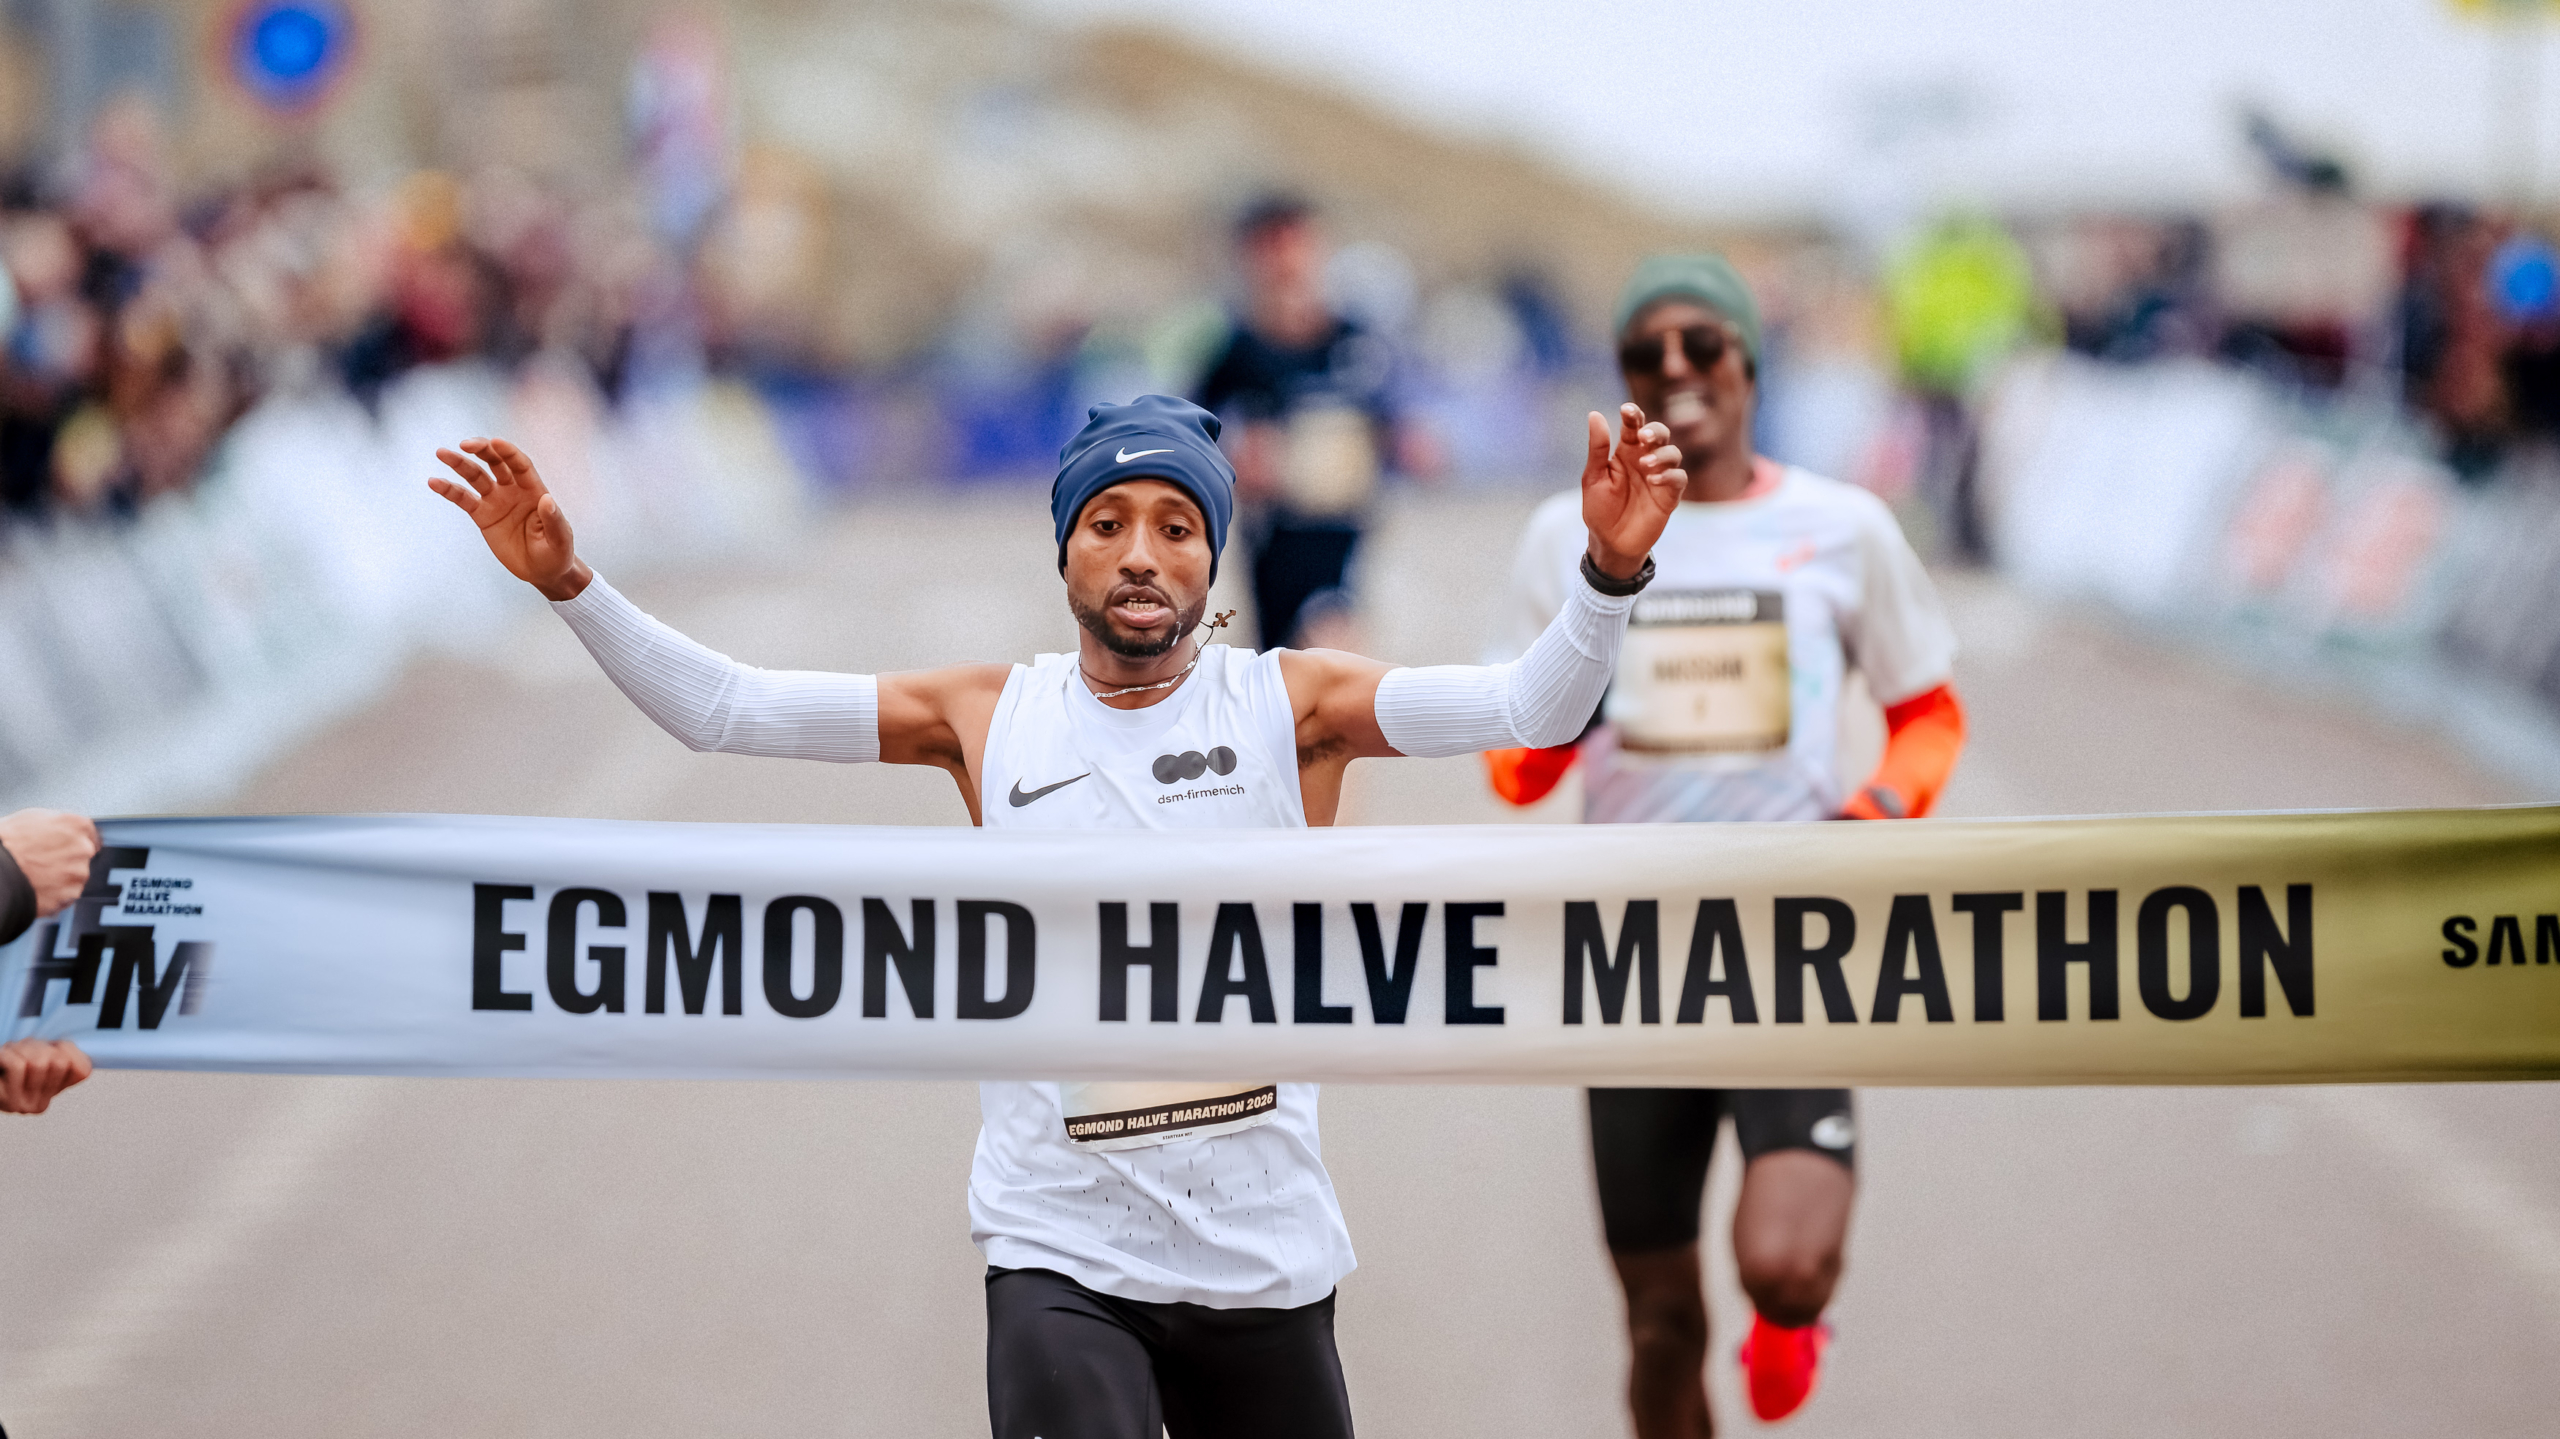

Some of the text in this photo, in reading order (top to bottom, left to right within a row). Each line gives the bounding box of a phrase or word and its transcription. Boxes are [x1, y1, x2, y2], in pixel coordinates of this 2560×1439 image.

[1157, 784, 1245, 804] dsm-firmenich
[130, 877, 193, 889] EGMOND
[123, 904, 203, 915] MARATHON
[472, 881, 2317, 1025] EGMOND HALVE MARATHON
[1069, 1092, 1274, 1136] EGMOND HALVE MARATHON 2026
